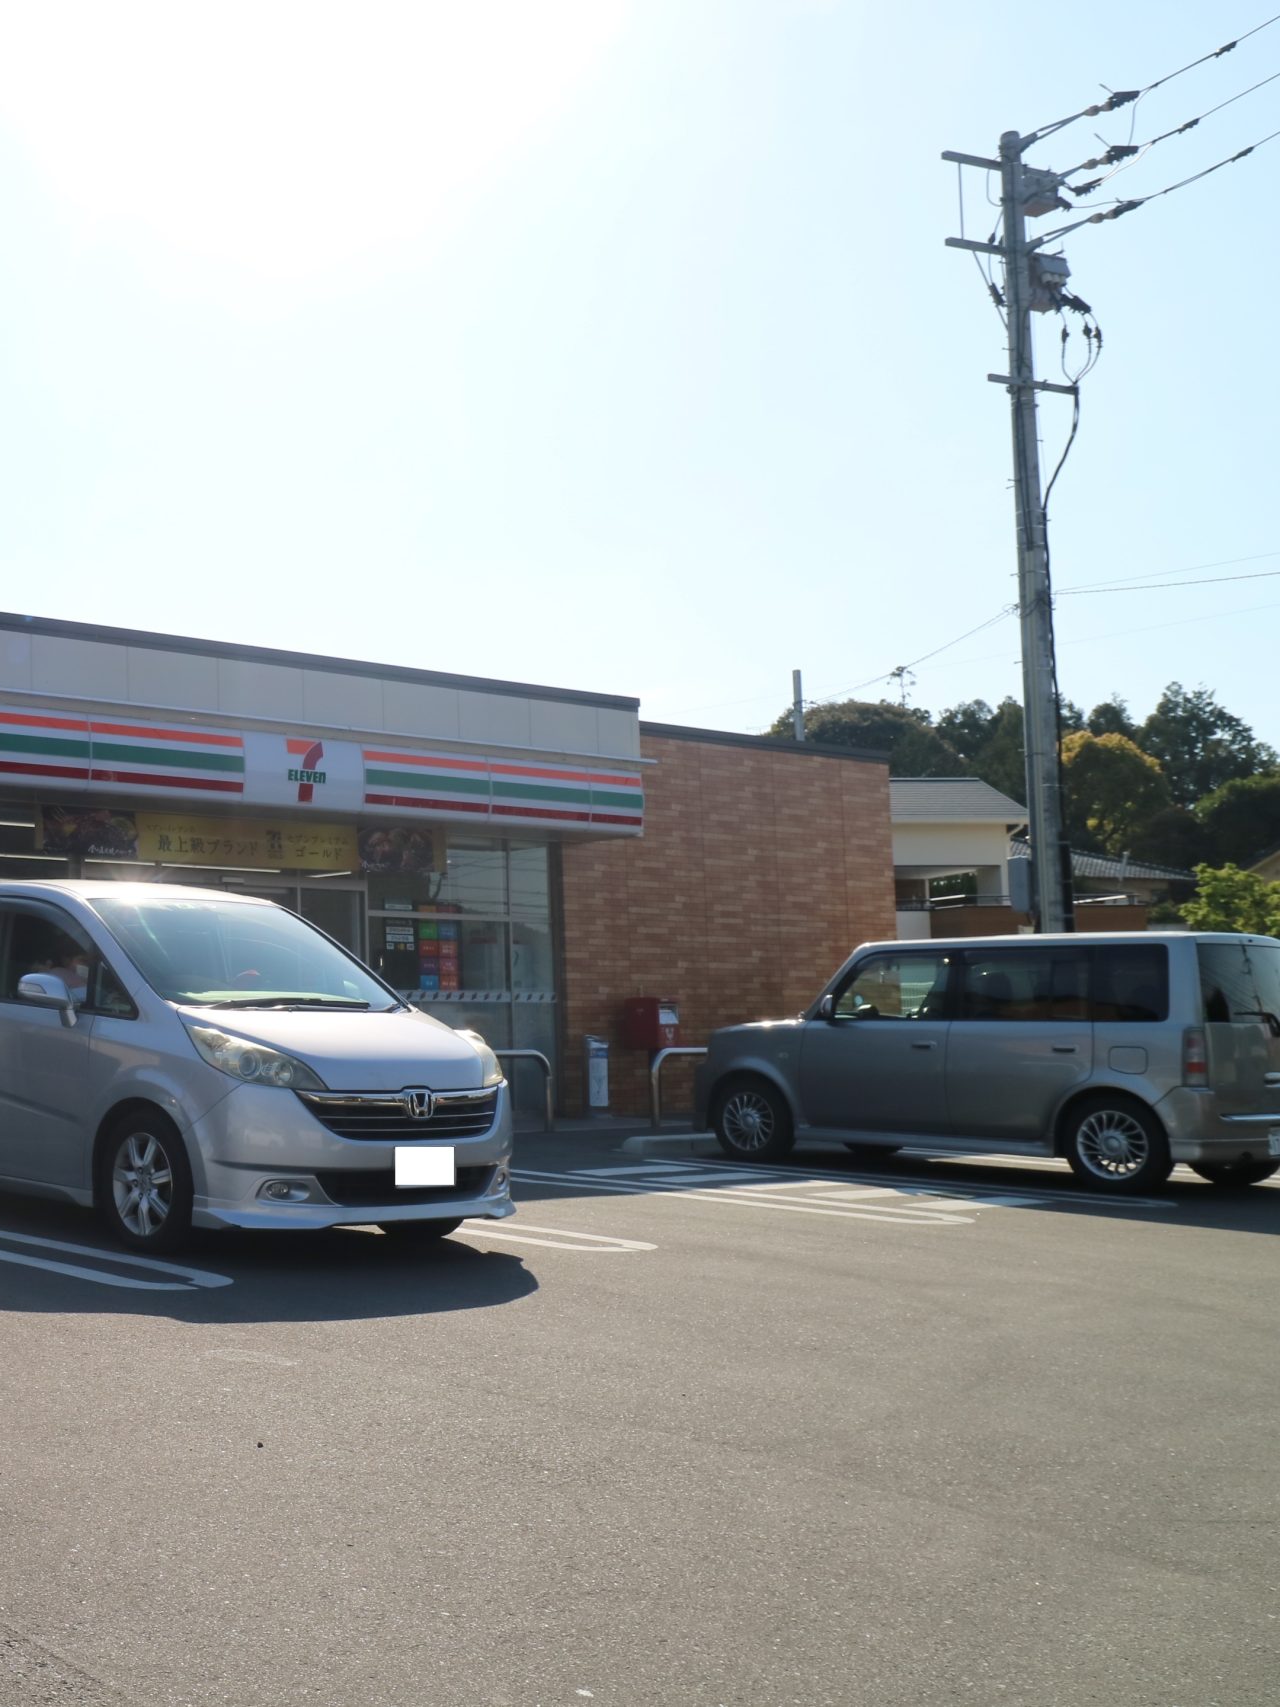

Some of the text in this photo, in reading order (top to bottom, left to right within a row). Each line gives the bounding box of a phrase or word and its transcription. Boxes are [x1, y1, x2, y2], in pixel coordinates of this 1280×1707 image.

[158, 834, 258, 856] 最上級ブランド
[295, 845, 342, 861] ゴールド
